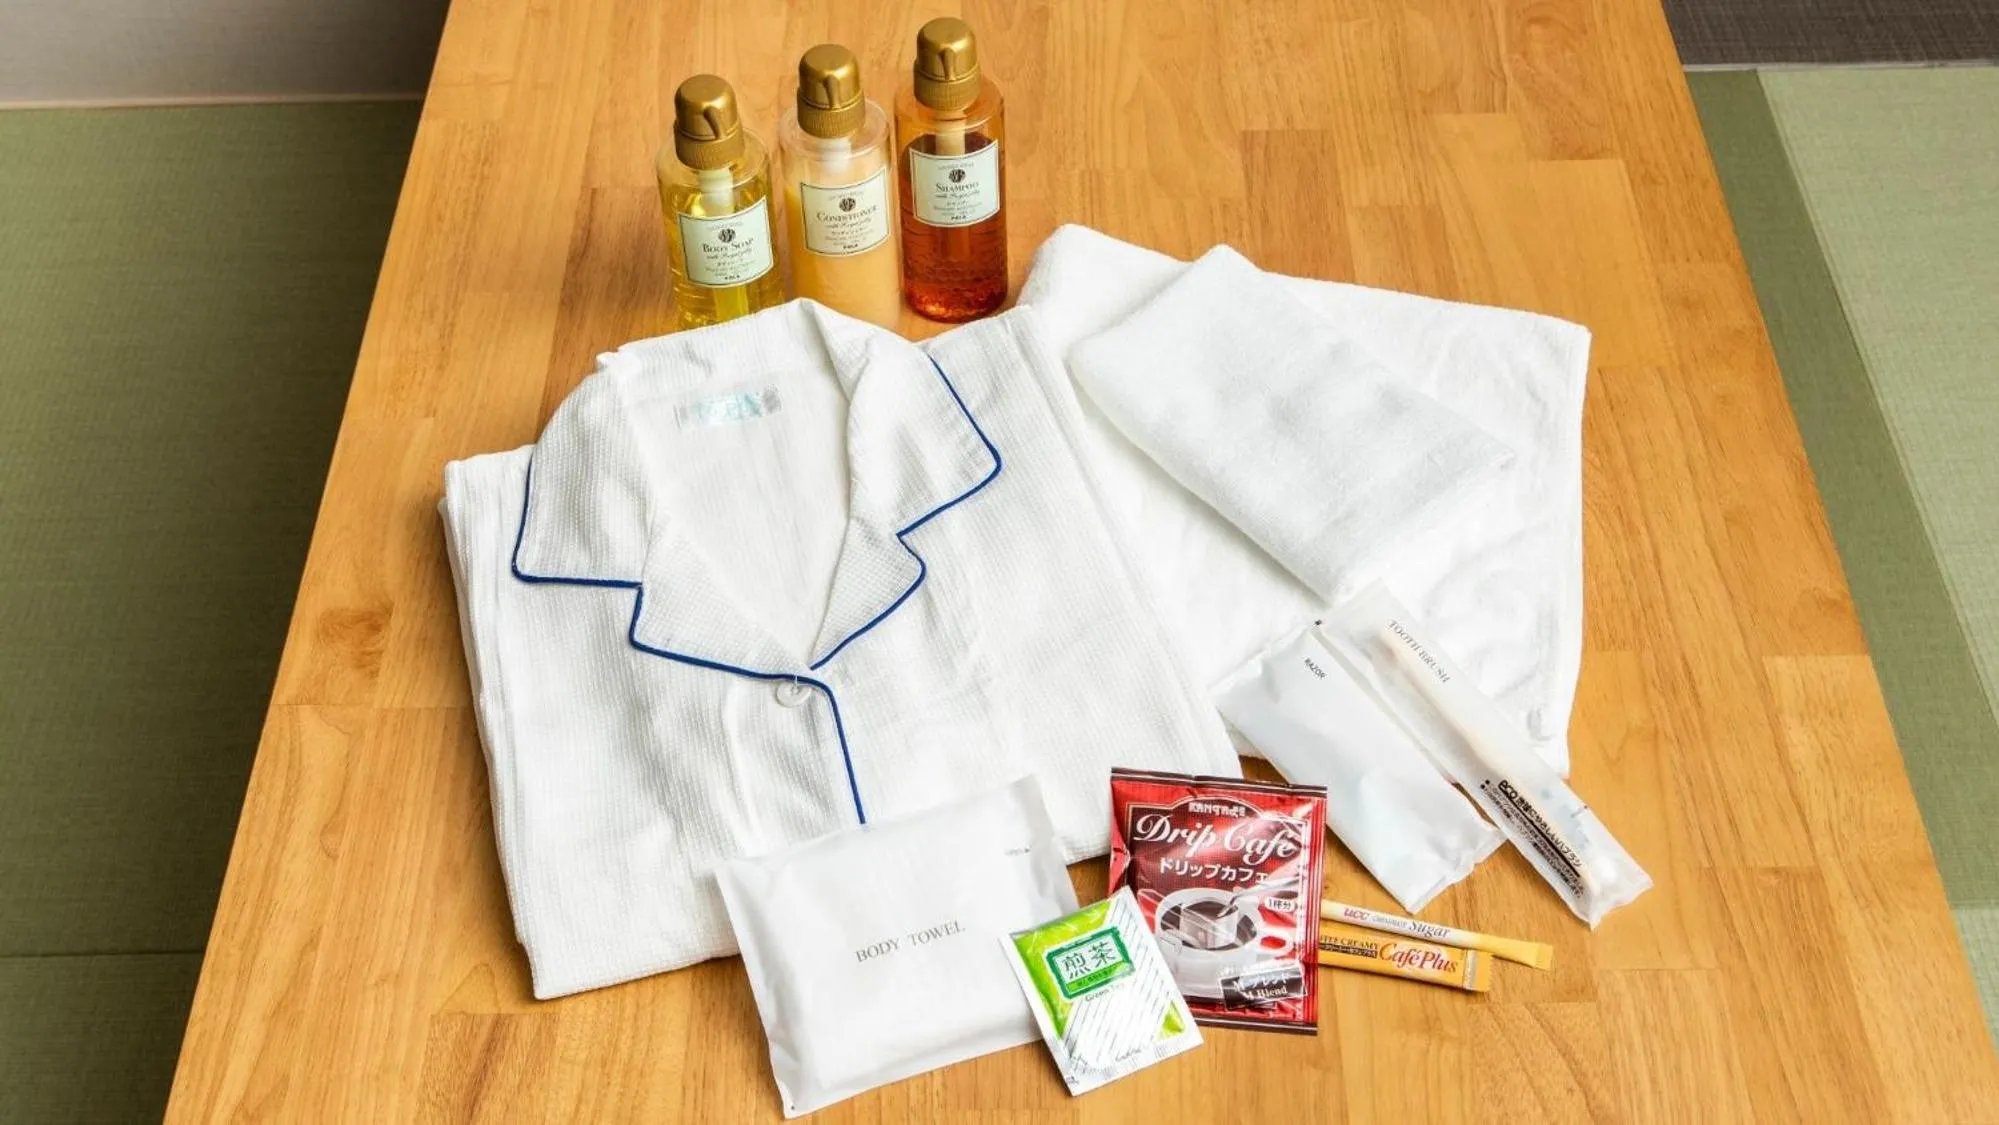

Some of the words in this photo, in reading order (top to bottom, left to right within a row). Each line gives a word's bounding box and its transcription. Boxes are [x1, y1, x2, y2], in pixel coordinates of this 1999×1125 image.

[1388, 619, 1420, 655] TOOTH
[1419, 648, 1450, 683] BRUSH
[1304, 657, 1327, 680] RAZOR
[1498, 779, 1519, 801] eco
[1133, 813, 1216, 858] Drip
[1159, 856, 1269, 883] ドリップカフェ
[855, 938, 901, 963] BODY
[907, 920, 966, 947] TOWEL
[1408, 920, 1451, 938] Sugar
[1062, 940, 1116, 979] 煎茶
[1255, 984, 1289, 998] Blend
